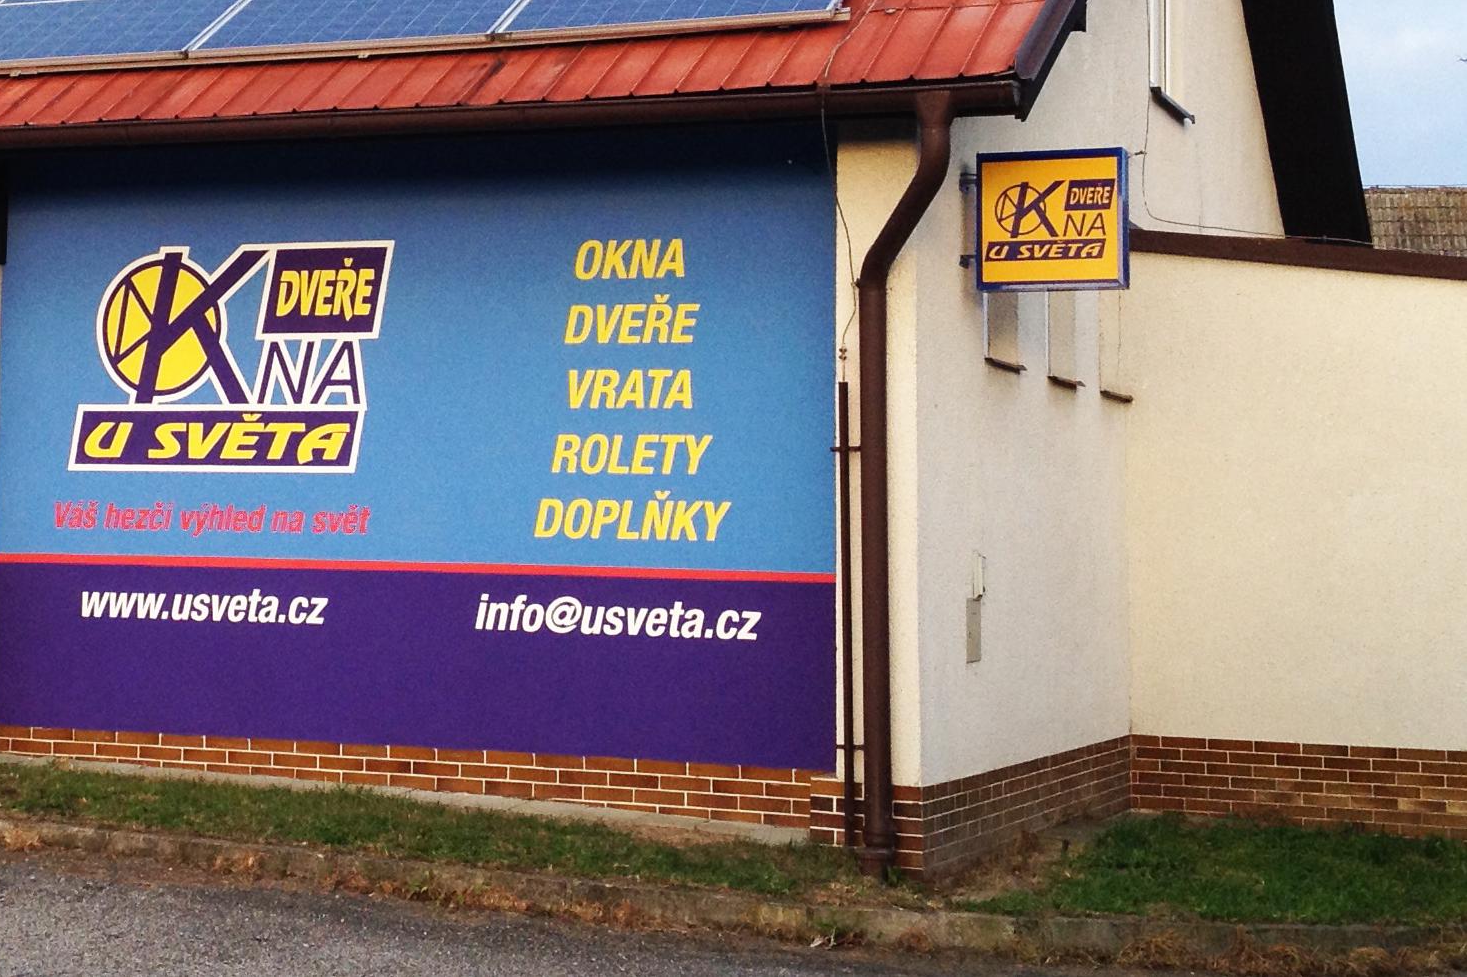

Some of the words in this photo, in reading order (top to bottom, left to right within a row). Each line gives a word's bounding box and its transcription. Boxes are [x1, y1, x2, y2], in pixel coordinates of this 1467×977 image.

[1069, 182, 1111, 206] DVEŘE
[574, 237, 686, 280] OKNA
[988, 245, 1009, 259] U
[1016, 240, 1103, 259] SVĚTA
[275, 257, 376, 322] DVEŘE
[564, 293, 701, 345] DVEŘE
[567, 368, 694, 410] VRATA
[83, 421, 134, 459] U
[148, 413, 351, 465] SVĚTA
[551, 433, 713, 476] ROLETY
[54, 500, 99, 530] Váš
[104, 501, 175, 531] hezčí
[179, 503, 267, 538] výhled
[271, 509, 306, 534] na
[312, 504, 372, 535] svět
[533, 490, 732, 542] DOPLŇKY
[80, 588, 330, 626] www.usveta.cz
[474, 593, 763, 642] info@usveta.cz
